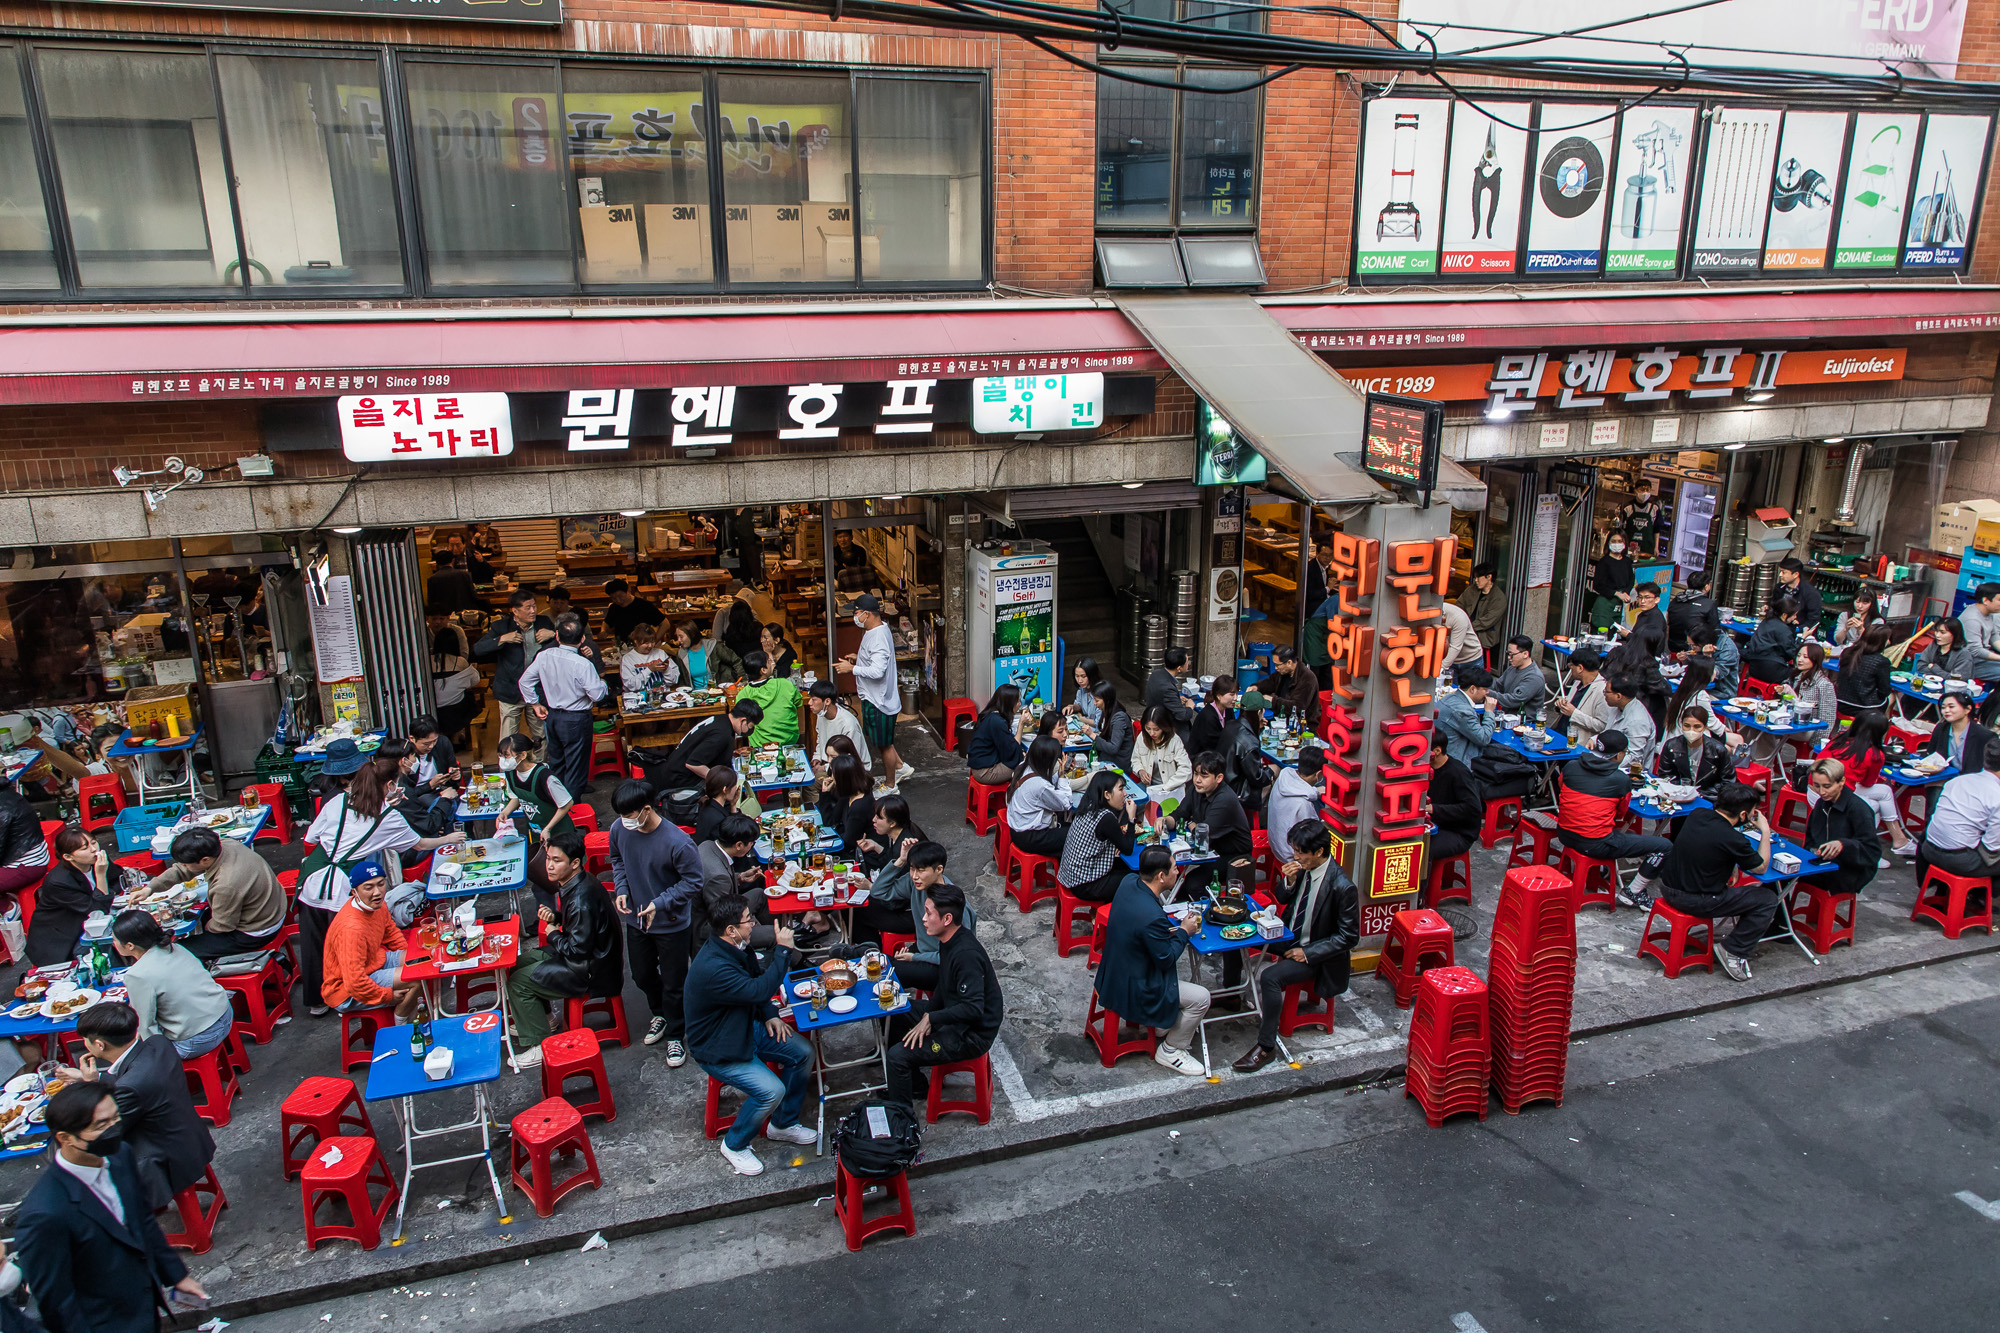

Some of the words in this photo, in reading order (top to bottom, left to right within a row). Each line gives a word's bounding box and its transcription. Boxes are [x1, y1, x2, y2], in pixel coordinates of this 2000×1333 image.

[1866, 42, 1926, 59] GERMANY
[608, 207, 633, 222] 3M
[672, 207, 696, 220] 3M
[726, 207, 748, 221] 3M
[776, 207, 800, 221] 3M
[827, 207, 850, 221] 3M
[1361, 255, 1407, 269] SONANE
[1410, 258, 1429, 268] Cart
[1443, 254, 1474, 268] NIKO
[1480, 258, 1510, 268] Scissors
[1528, 254, 1562, 267] PFERD
[1561, 257, 1582, 266] Cut-off
[1582, 257, 1597, 266] discs
[1608, 254, 1645, 268] SONANE
[1644, 258, 1661, 268] Spray
[1663, 259, 1675, 268] gun
[1694, 252, 1720, 266] TOHO
[1721, 256, 1739, 265] Chain
[1740, 256, 1757, 267] slings
[1764, 252, 1797, 266] SANOU
[1800, 255, 1820, 265] Chuck
[1836, 251, 1873, 263] SONANE
[1873, 252, 1895, 262] Ladder
[1904, 250, 1934, 263] PFERD
[1425, 333, 1445, 344] Since
[1447, 333, 1465, 343] 1989
[898, 361, 941, 375] 뮌헨호프
[1084, 356, 1109, 368] Since
[1111, 355, 1134, 366] 1989
[1822, 357, 1896, 378] Euljirofest
[131, 378, 191, 395] 뮌헨호프
[198, 376, 285, 393] 을지로노가리
[295, 374, 379, 391] 을지로골뱅이
[386, 376, 417, 388] Since
[421, 374, 451, 386] 1989
[1396, 376, 1435, 394] 1989
[1485, 346, 1743, 412] 뮌헨호프
[983, 375, 1067, 403] 골뱅이
[353, 397, 465, 428] 을지로
[561, 379, 938, 452] 뮌헨호프
[391, 427, 500, 457] 노가리
[1214, 449, 1234, 463] TERRA
[1557, 482, 1583, 499] TERRA
[1225, 505, 1236, 514] 14
[575, 541, 593, 551] Max
[996, 575, 1052, 592] 냉수전용냉장고
[1012, 591, 1036, 602] (Self)
[1025, 655, 1047, 665] TERRA
[1372, 536, 1454, 841] 뮌헨호프
[269, 773, 294, 783] TERRA
[467, 1014, 497, 1031] 73
